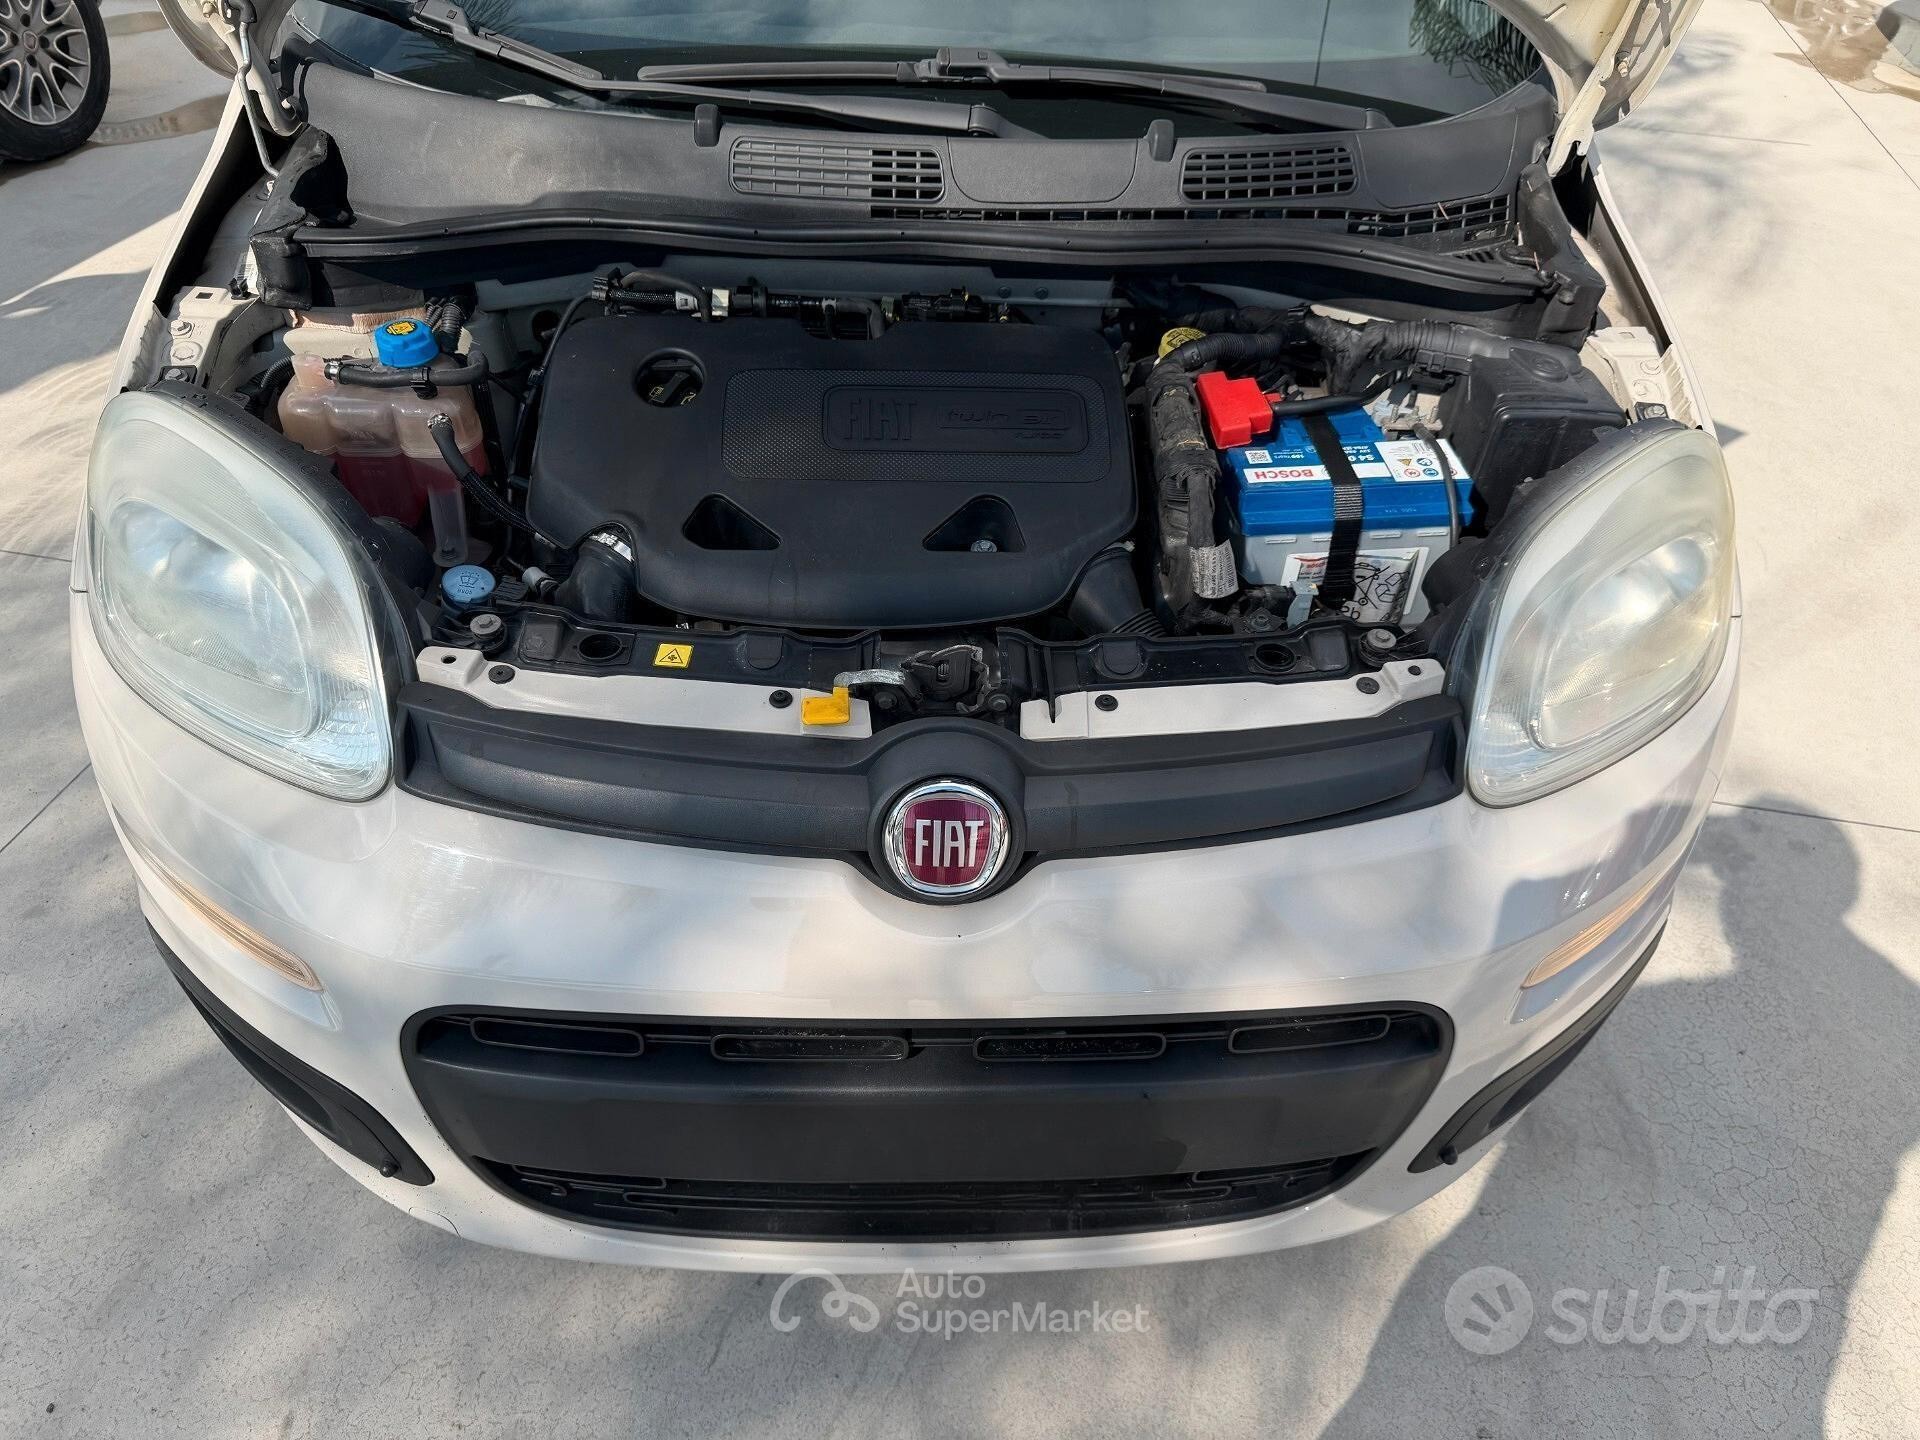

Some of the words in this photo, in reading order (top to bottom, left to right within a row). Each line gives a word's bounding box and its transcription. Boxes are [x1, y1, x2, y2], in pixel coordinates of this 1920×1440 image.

[844, 398, 917, 441] FIAT
[1254, 468, 1314, 480] BOSCH
[916, 819, 984, 867] FIAT
